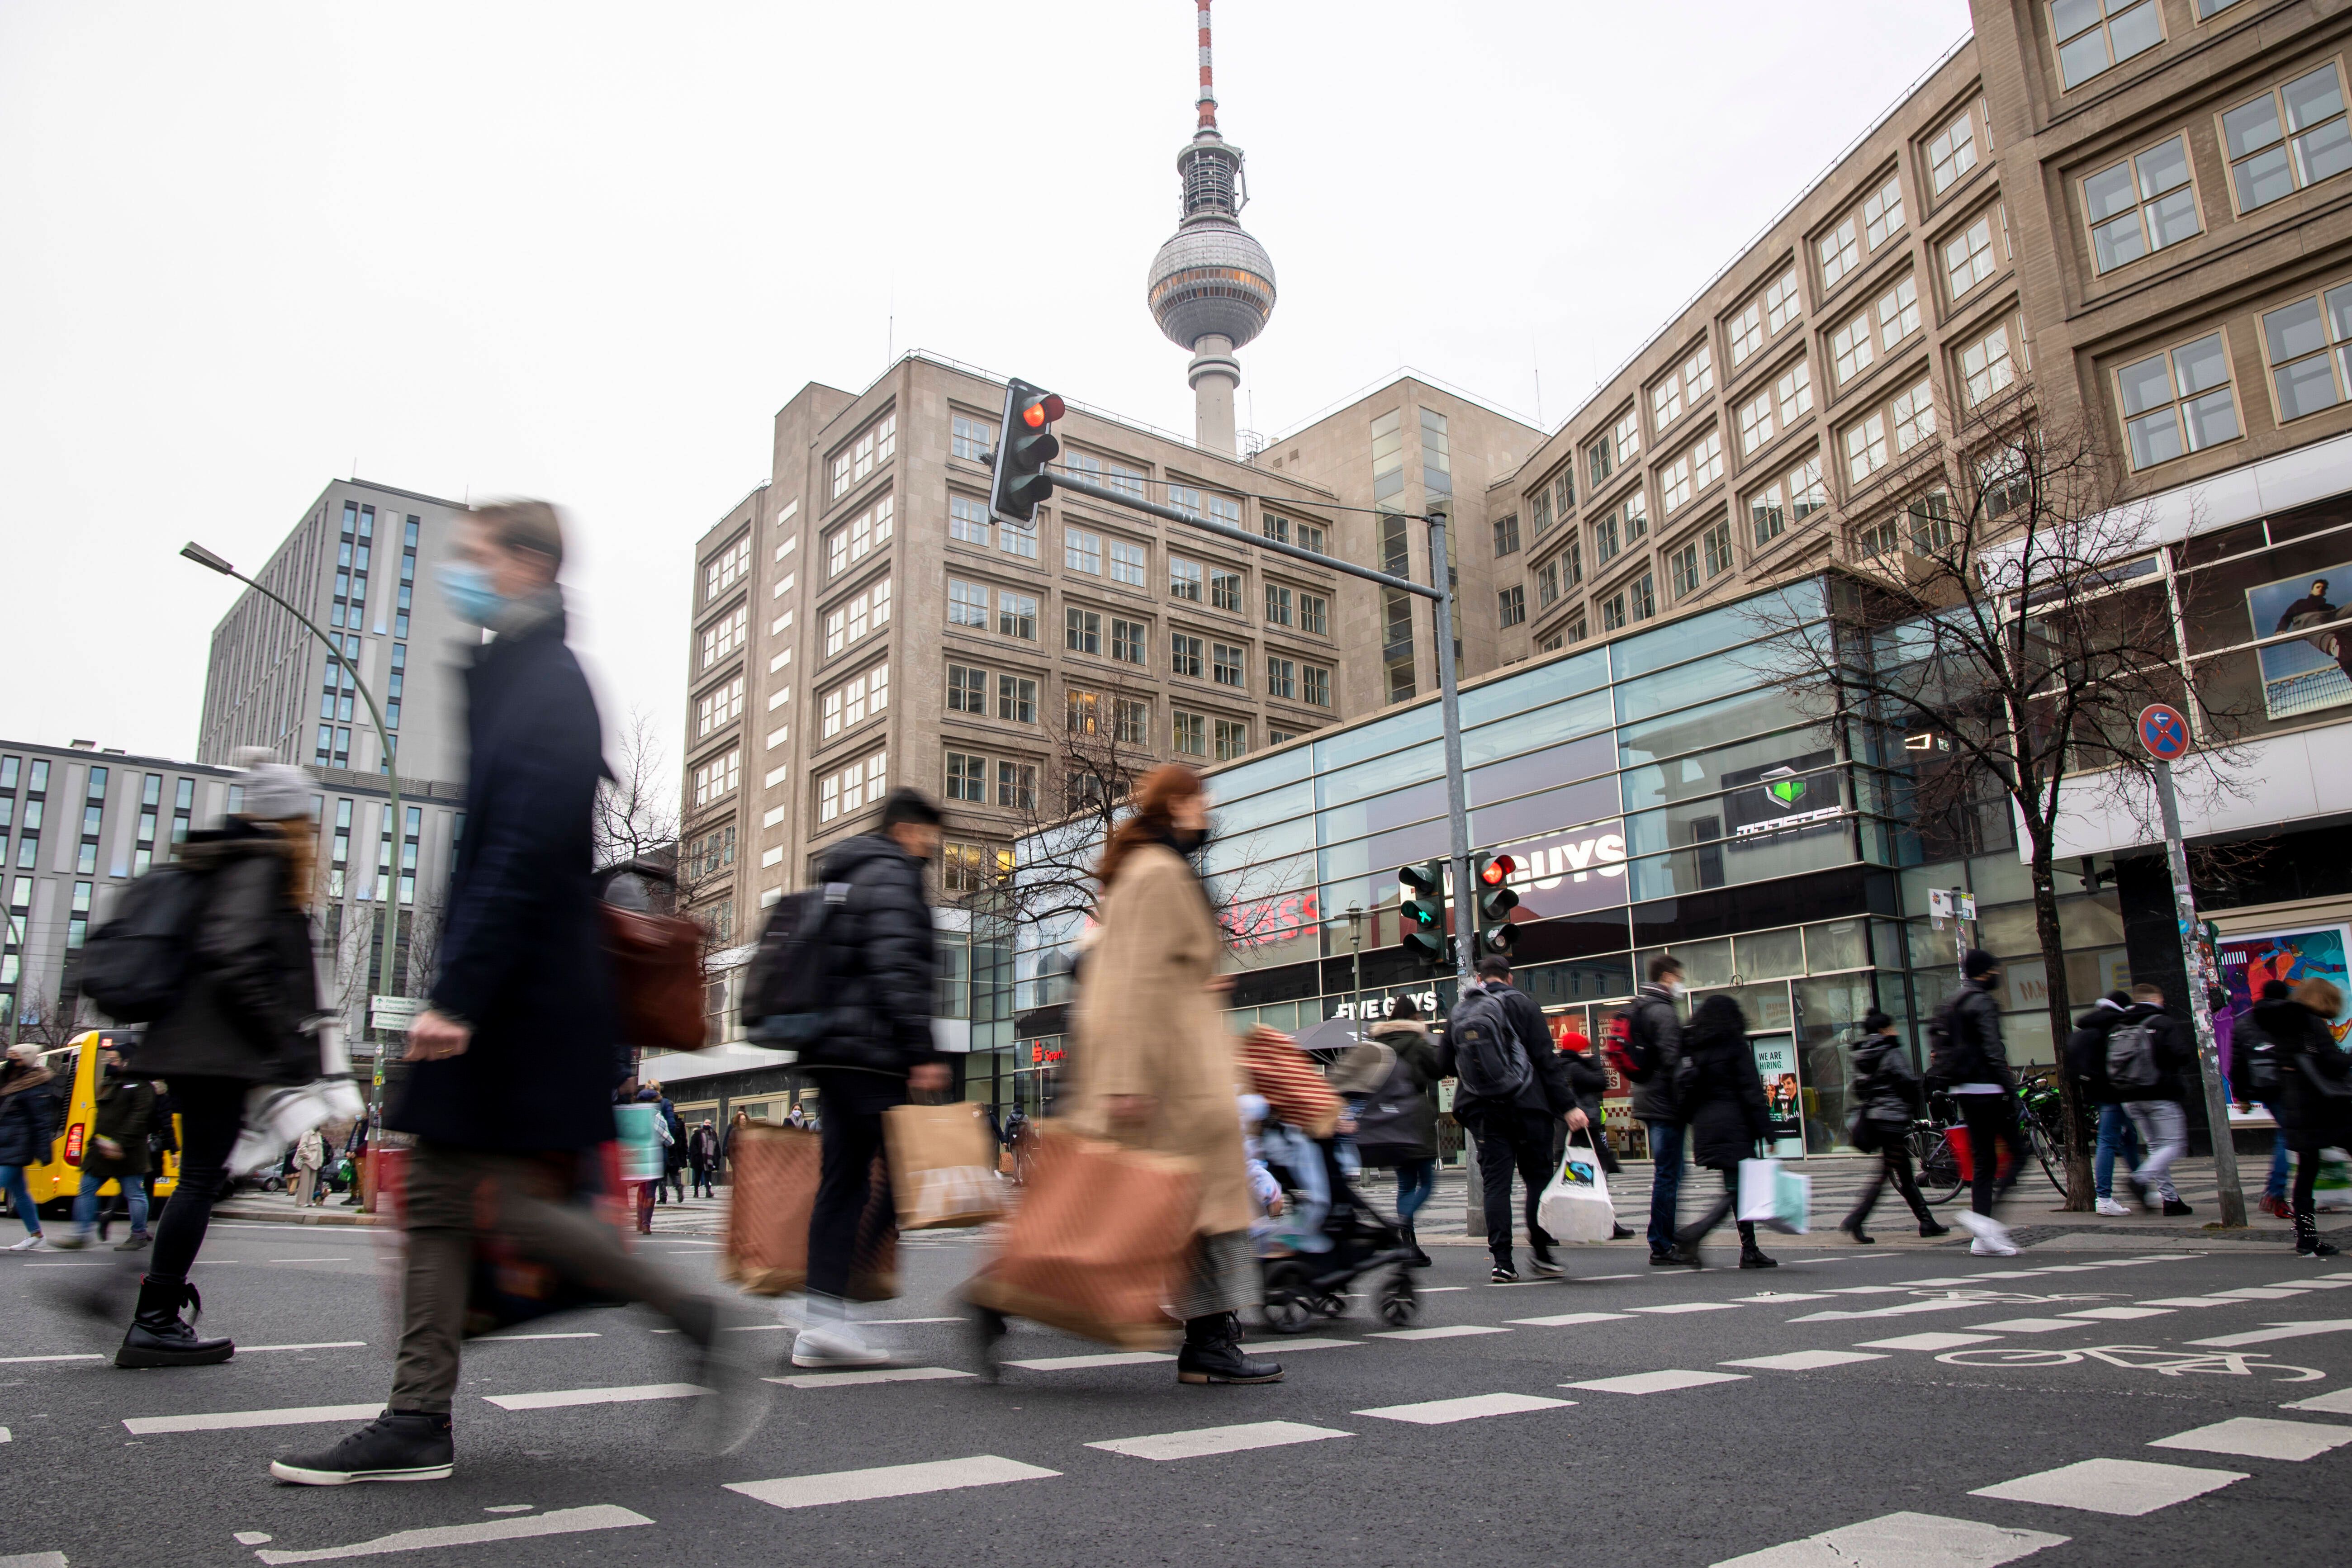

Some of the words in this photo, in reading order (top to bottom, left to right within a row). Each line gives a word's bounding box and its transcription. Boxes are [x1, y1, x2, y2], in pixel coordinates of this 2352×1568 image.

[1507, 834, 1626, 895] GUYS
[1383, 991, 1437, 1017] GYS
[1759, 1052, 1768, 1061] WE
[1770, 1051, 1782, 1061] ARE
[1759, 1061, 1783, 1070] HIRING.
